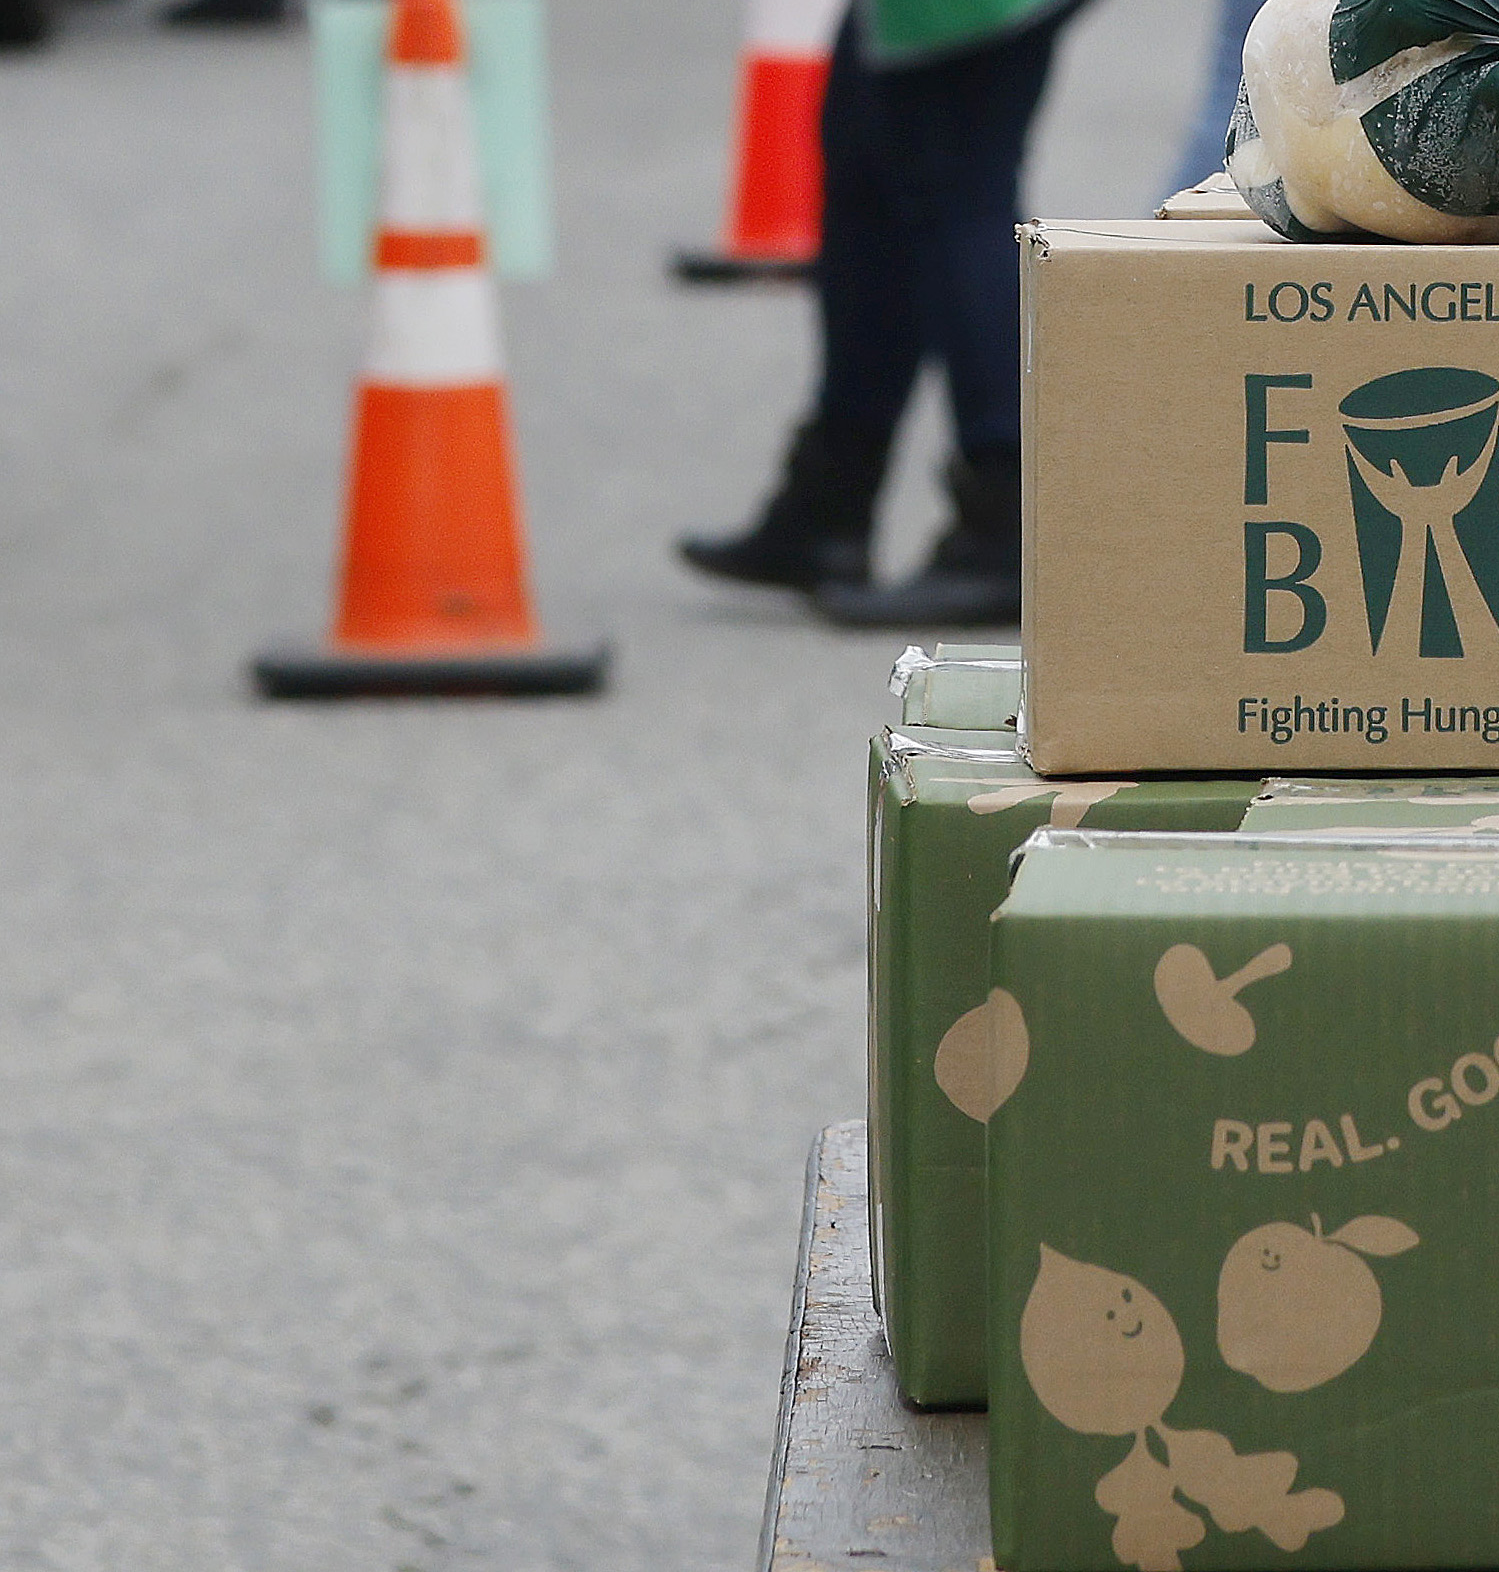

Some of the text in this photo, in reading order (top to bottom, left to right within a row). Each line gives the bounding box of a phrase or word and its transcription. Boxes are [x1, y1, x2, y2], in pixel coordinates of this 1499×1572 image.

[1246, 282, 1335, 323] LOS
[1238, 696, 1388, 745] Fighting
[1211, 1118, 1401, 1173] REAL.
